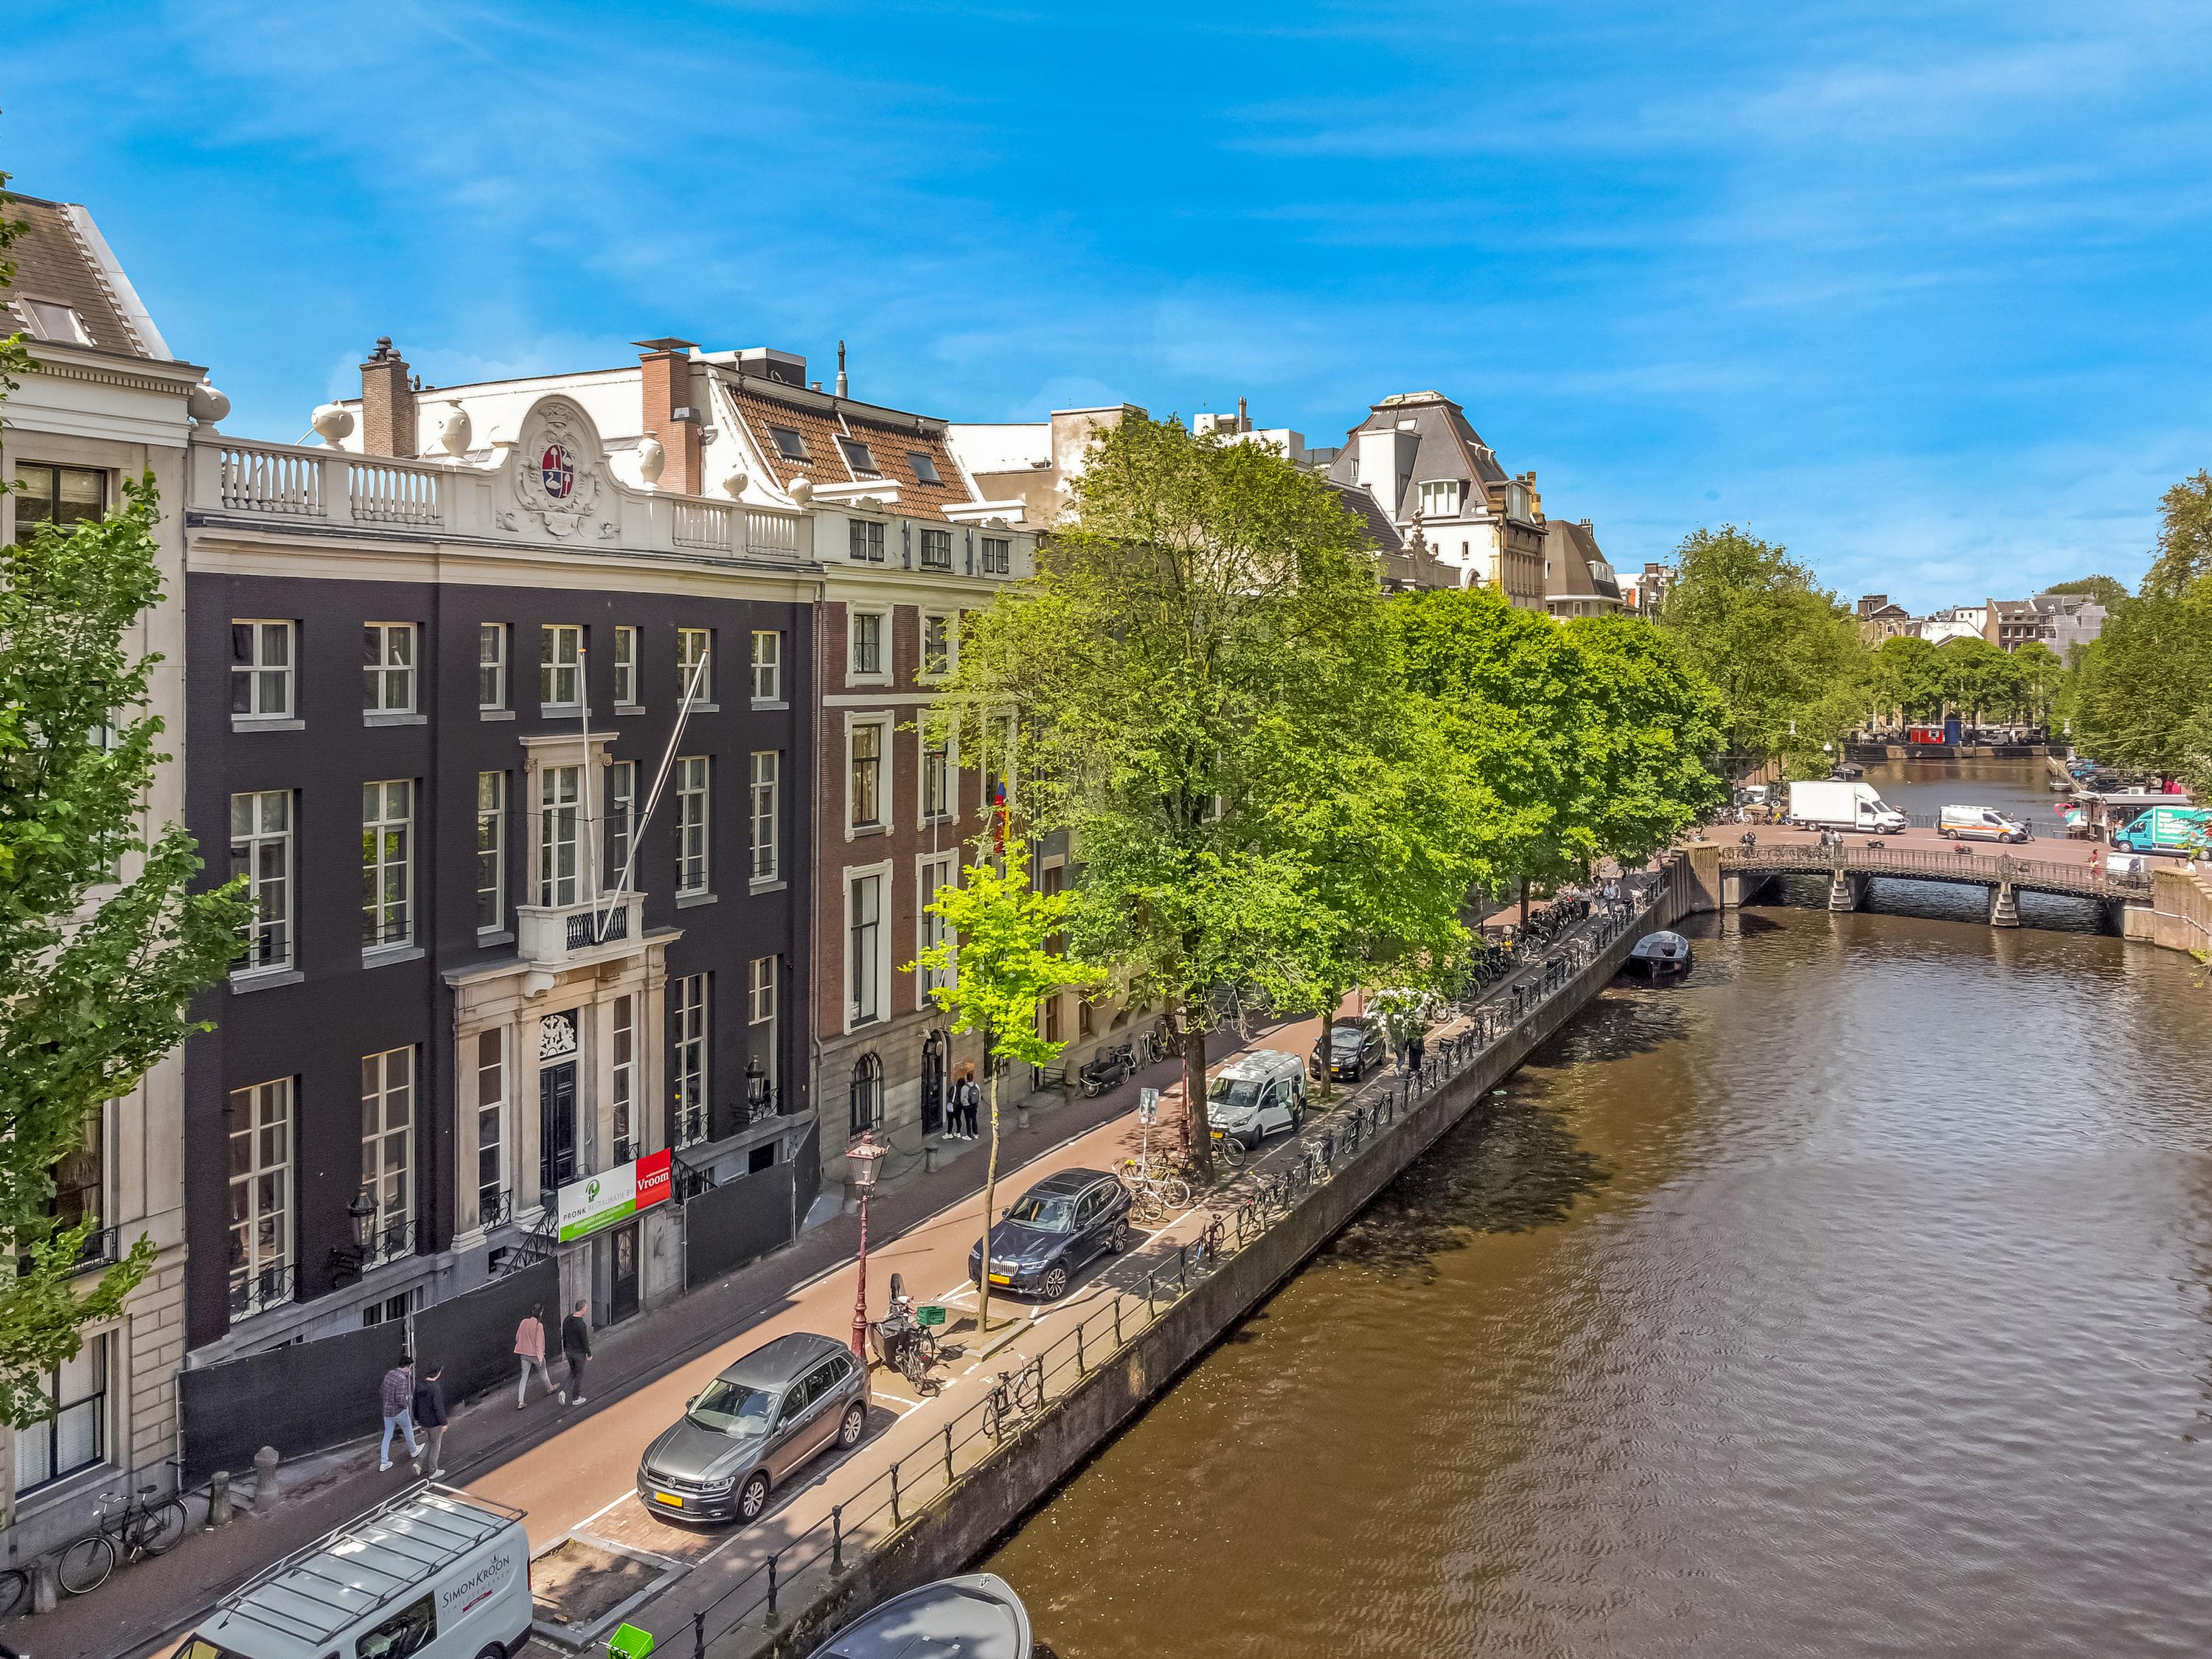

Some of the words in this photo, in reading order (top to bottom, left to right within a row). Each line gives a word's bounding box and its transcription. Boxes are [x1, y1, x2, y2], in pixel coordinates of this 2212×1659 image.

[637, 1172, 669, 1191] Vroom
[563, 1207, 586, 1221] PRONK
[588, 1192, 625, 1211] RESTAURATIE
